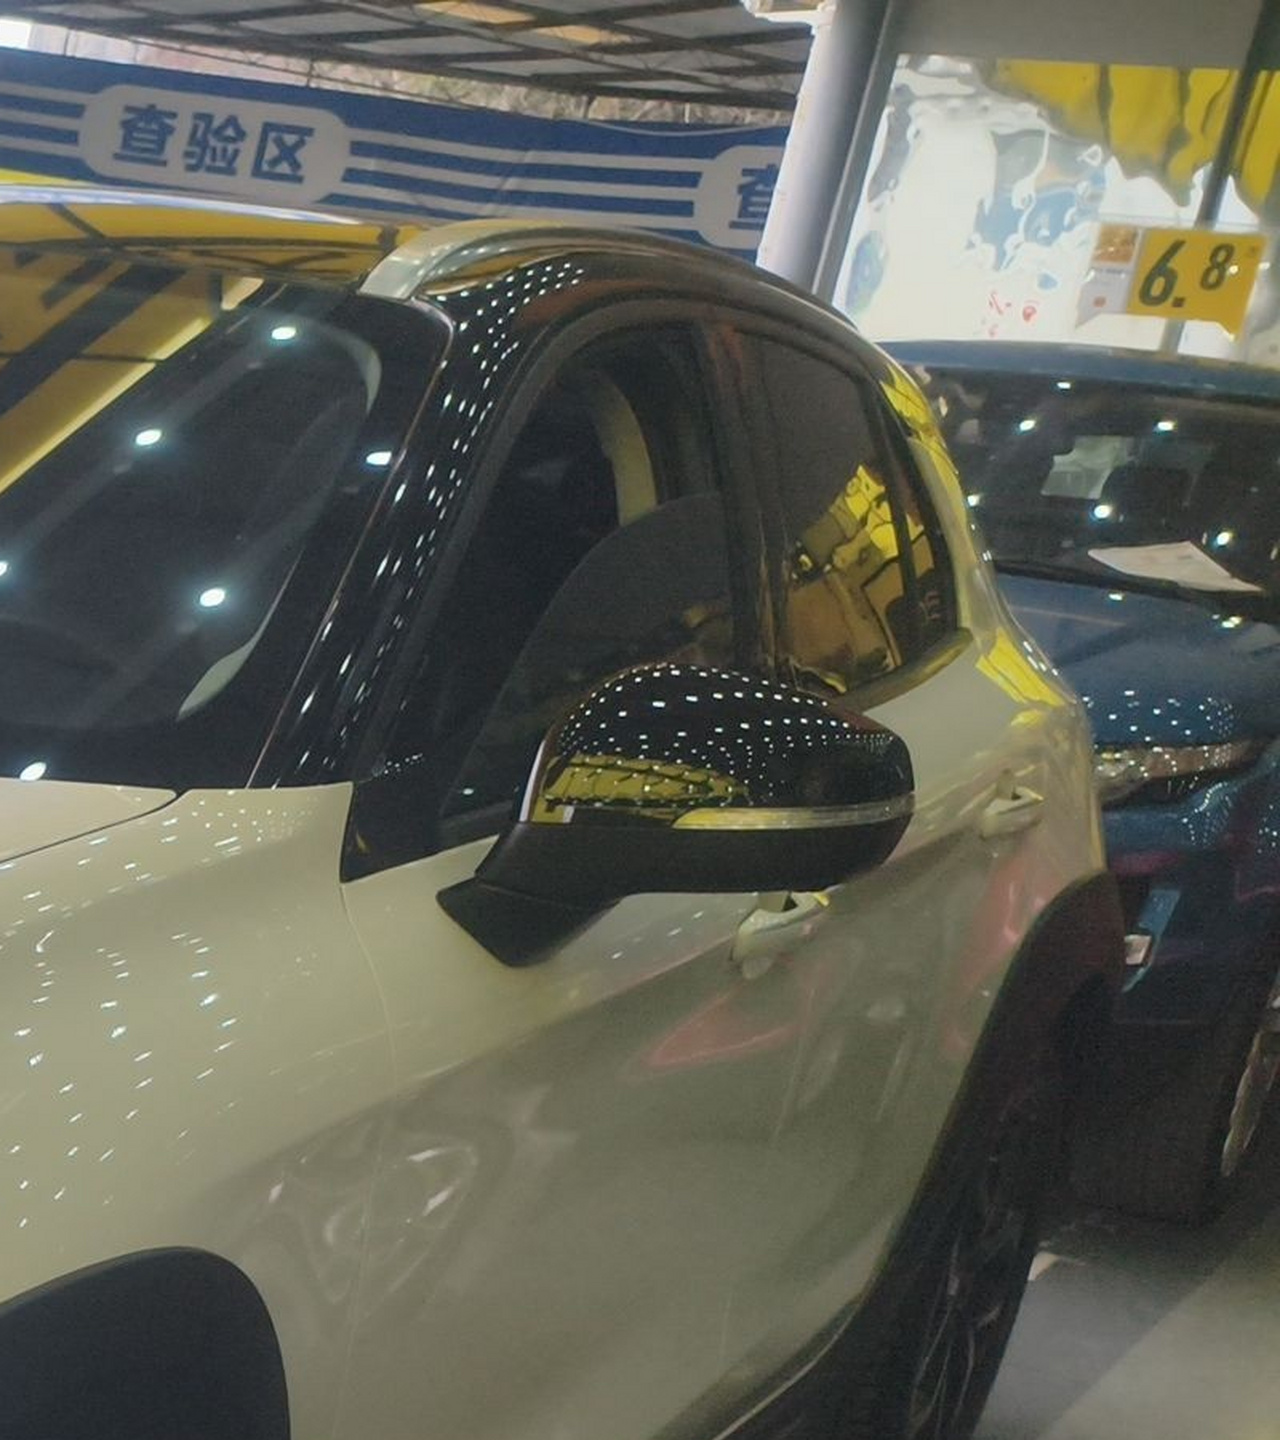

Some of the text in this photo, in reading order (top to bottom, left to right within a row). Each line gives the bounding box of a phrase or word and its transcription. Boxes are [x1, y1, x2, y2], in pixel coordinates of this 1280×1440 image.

[112, 104, 315, 183] 查验区
[1139, 239, 1235, 307] 6.8
